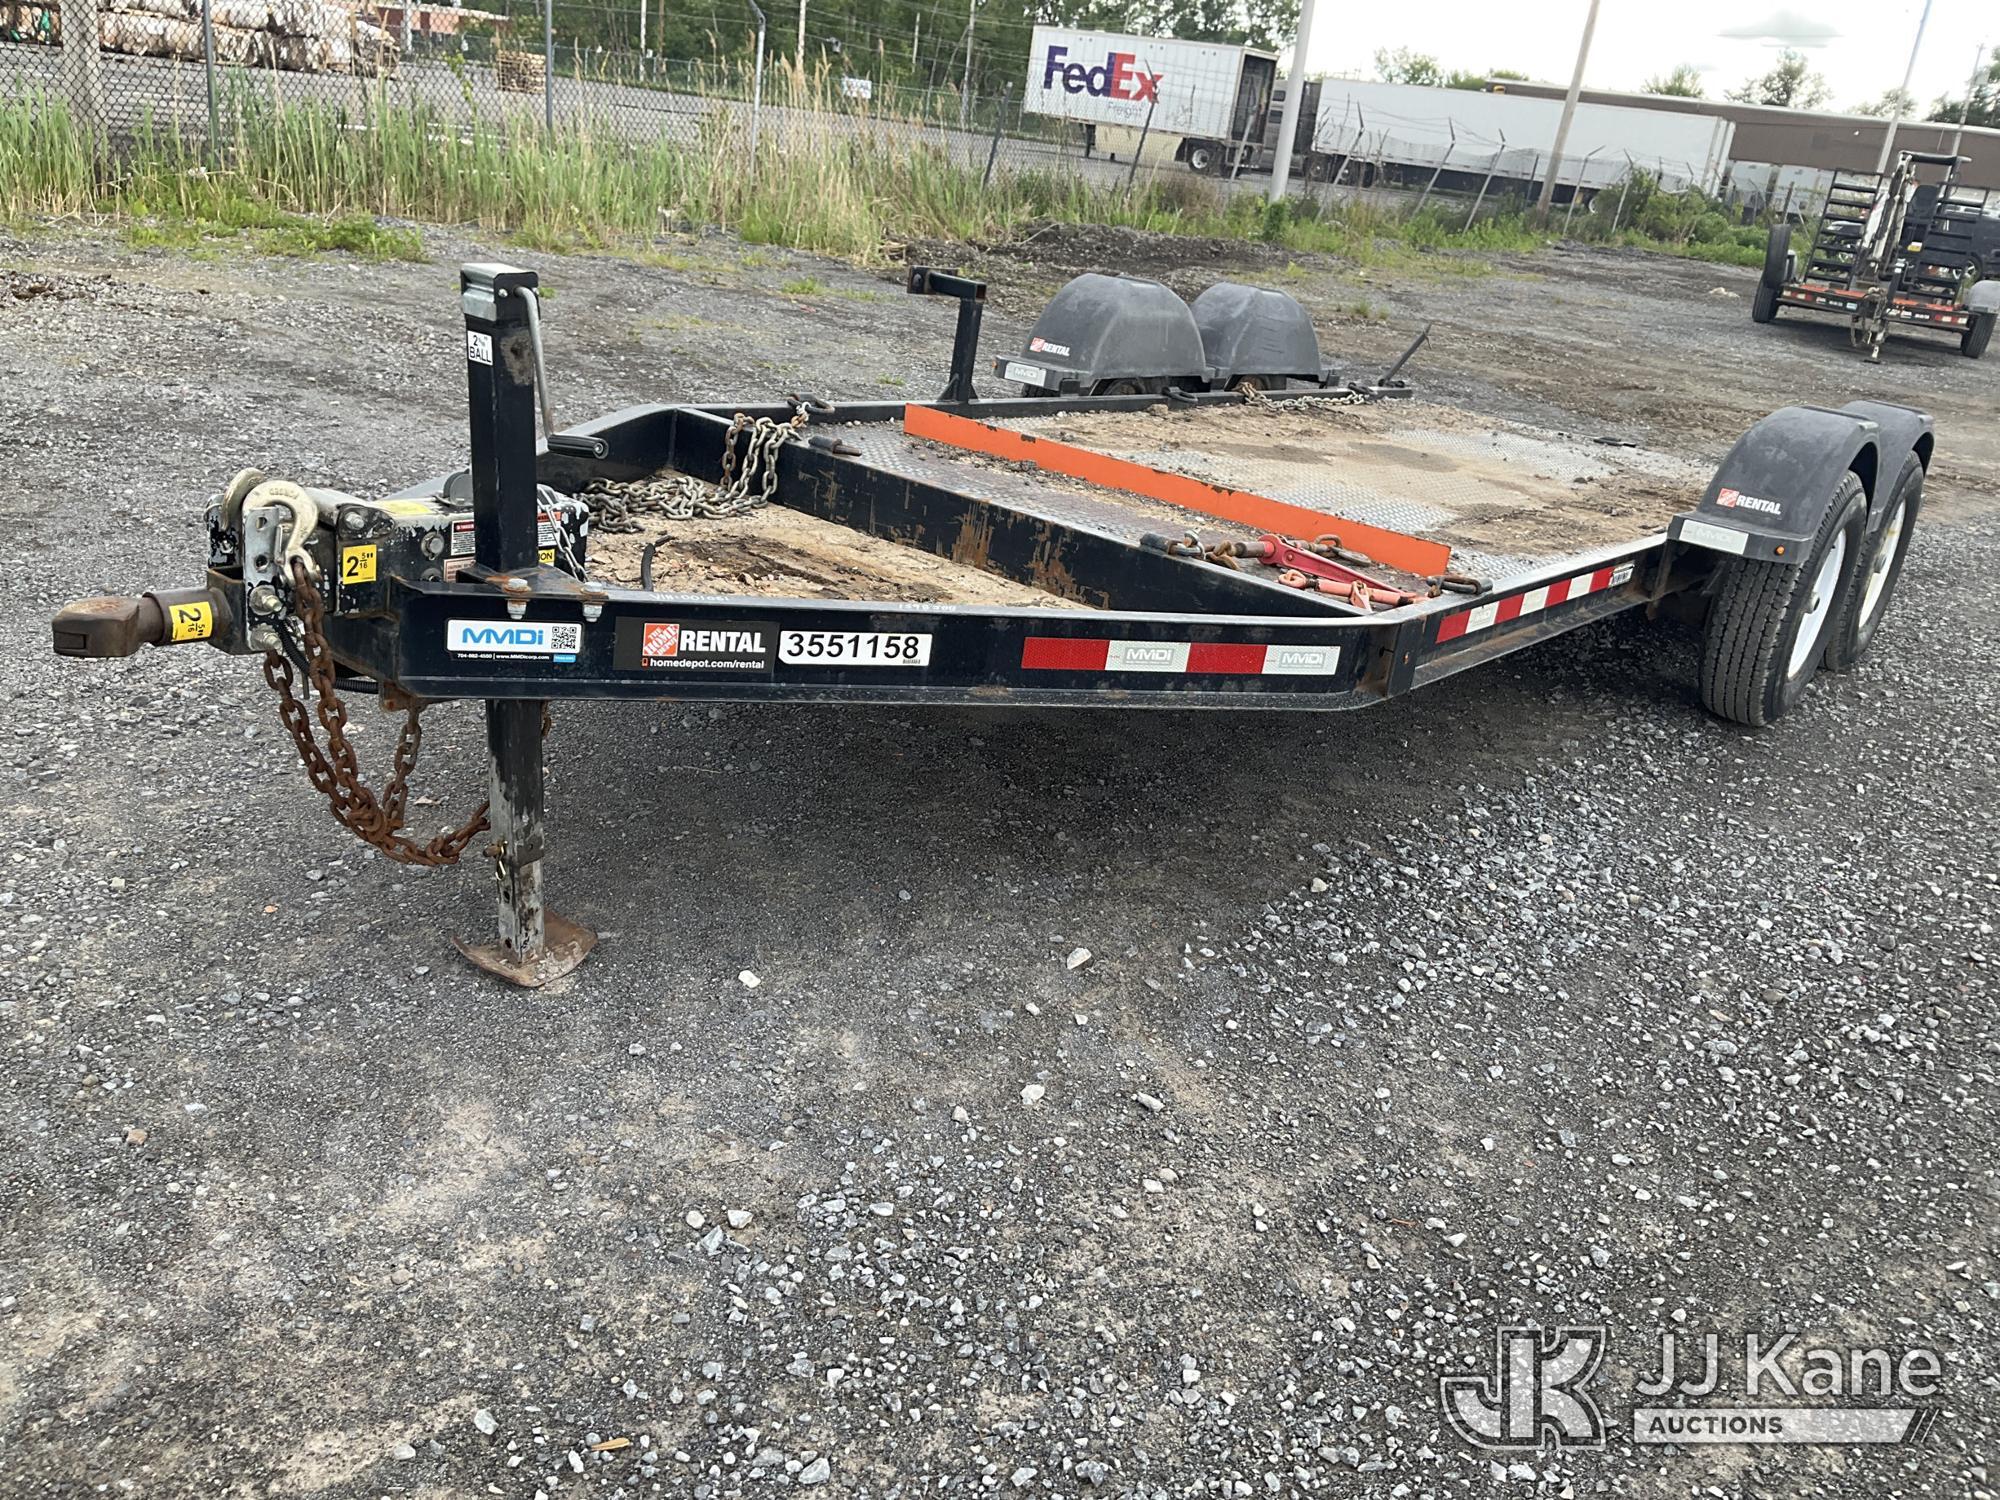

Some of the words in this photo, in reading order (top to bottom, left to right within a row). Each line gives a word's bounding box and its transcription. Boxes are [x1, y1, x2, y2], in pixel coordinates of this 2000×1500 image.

[1043, 45, 1164, 104] FedEx
[470, 346, 491, 363] BALL
[1041, 342, 1070, 356] RENTAL
[1736, 495, 1781, 515] RENTAL
[462, 628, 544, 645] MMDi
[680, 630, 766, 653] RENTAL
[787, 633, 919, 659] 3551158
[1126, 648, 1173, 660] MMDi
[650, 658, 765, 669] homedepot.com/rental
